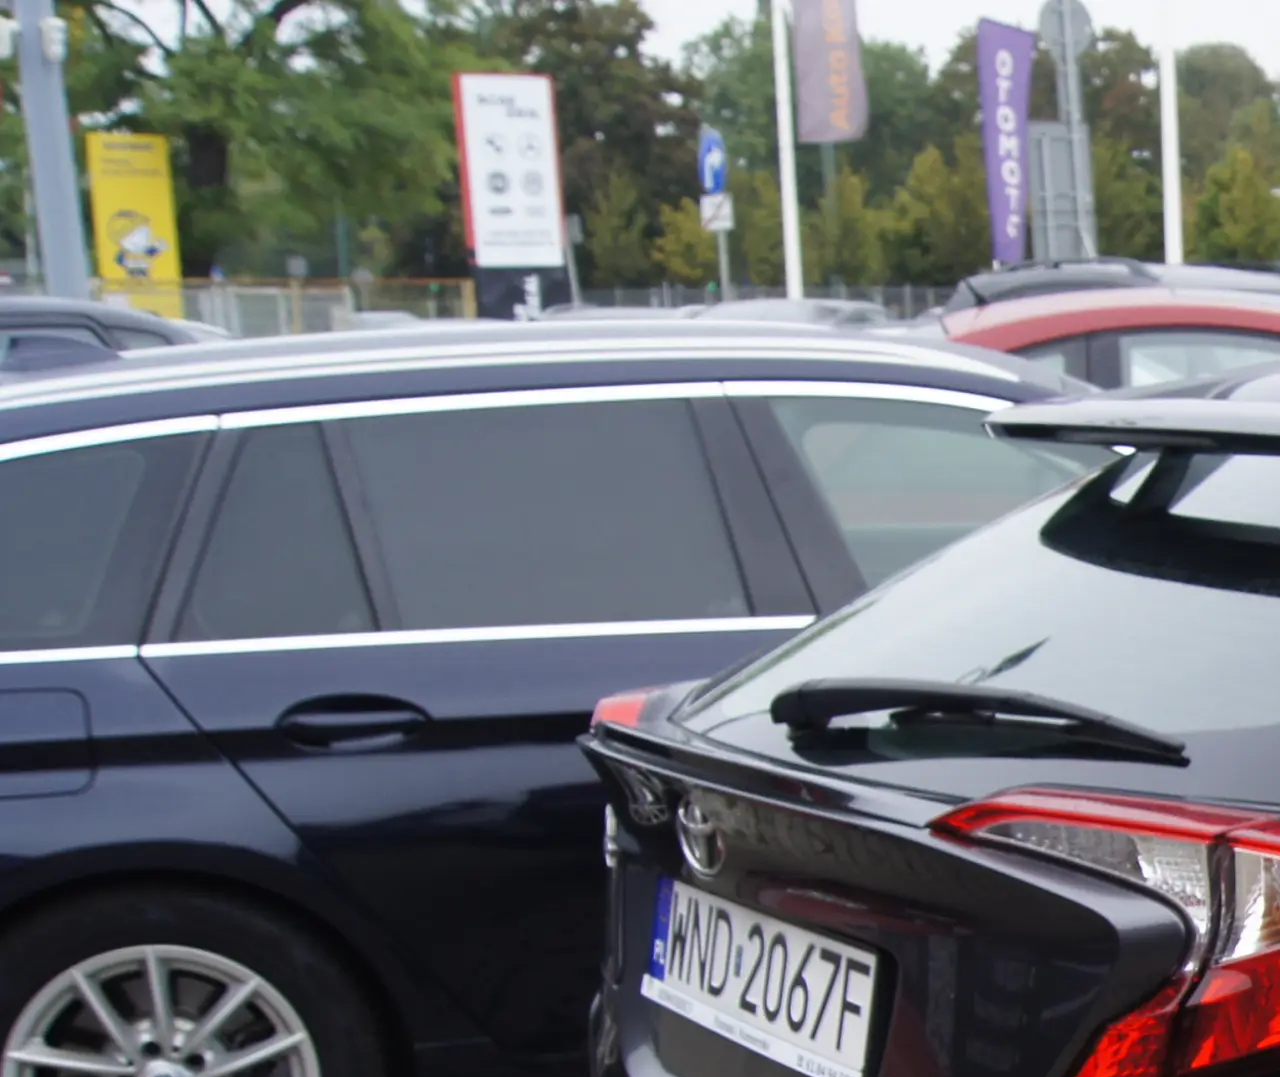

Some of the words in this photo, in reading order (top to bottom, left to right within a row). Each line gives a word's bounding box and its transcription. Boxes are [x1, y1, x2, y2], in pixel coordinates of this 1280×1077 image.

[653, 939, 665, 965] PL
[668, 891, 733, 997] WND
[739, 922, 870, 1052] 2067F
